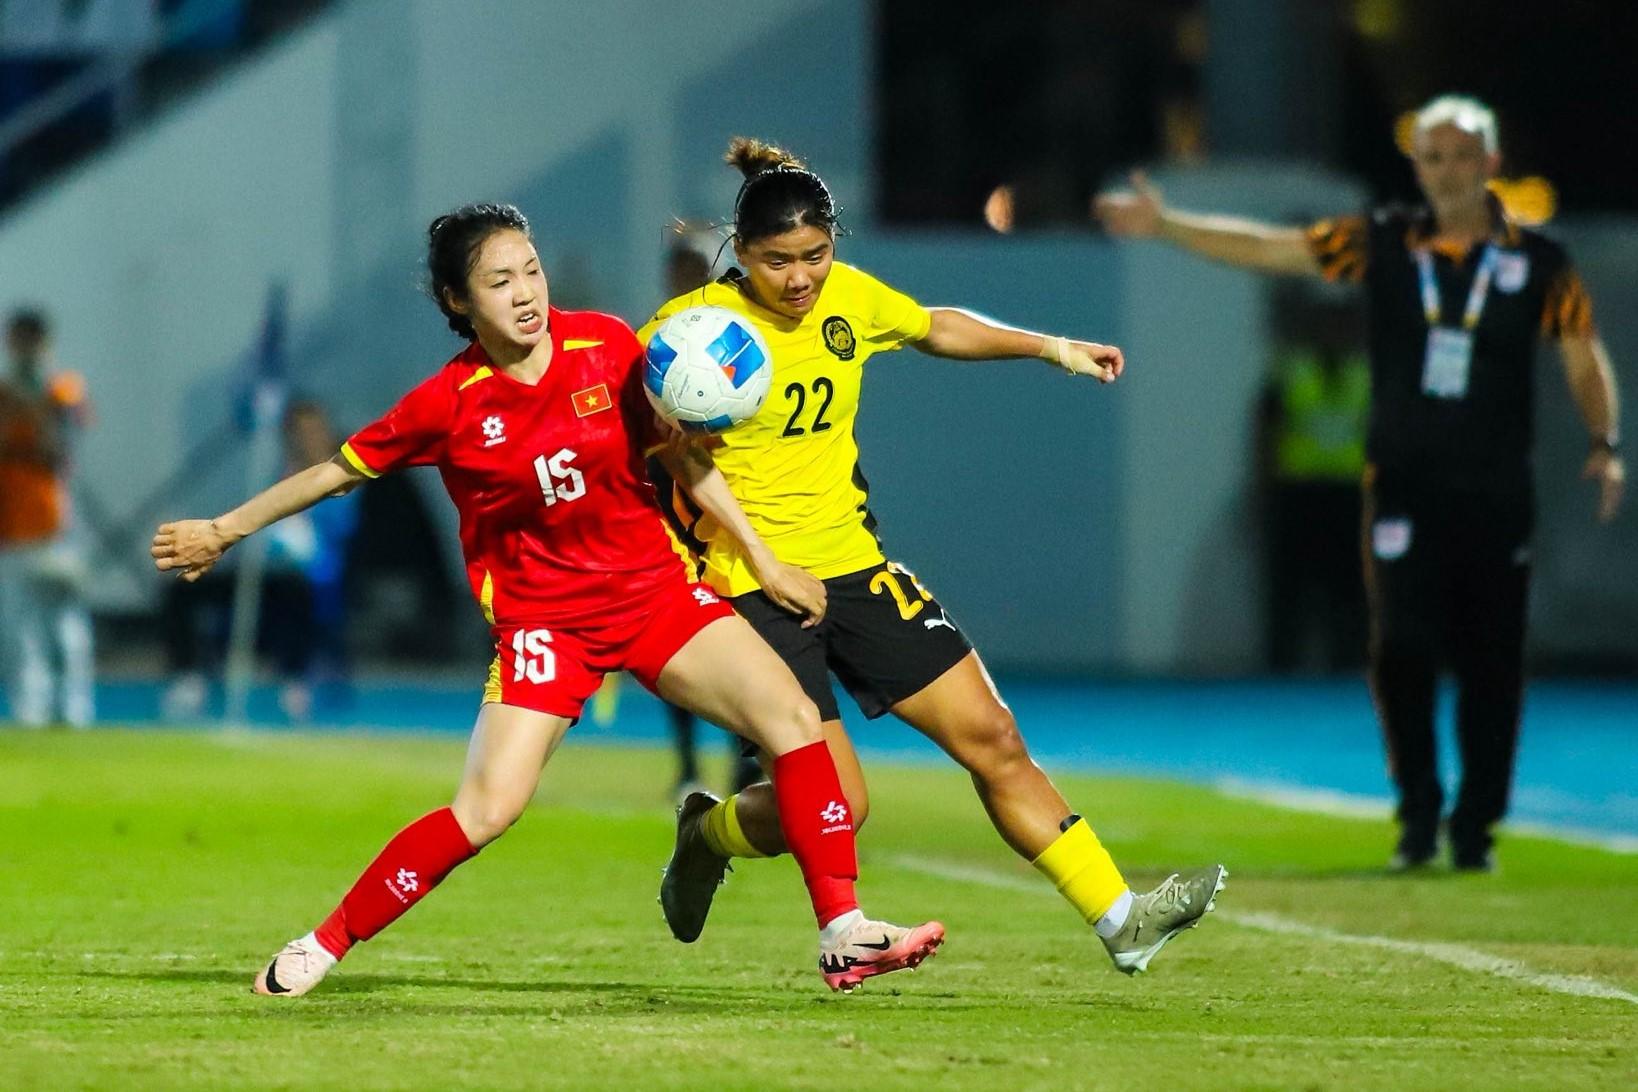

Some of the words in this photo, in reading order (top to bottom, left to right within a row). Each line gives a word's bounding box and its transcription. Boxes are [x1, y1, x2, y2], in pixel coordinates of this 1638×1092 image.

[782, 376, 834, 438] 22
[533, 447, 587, 507] 15
[512, 628, 556, 685] 15
